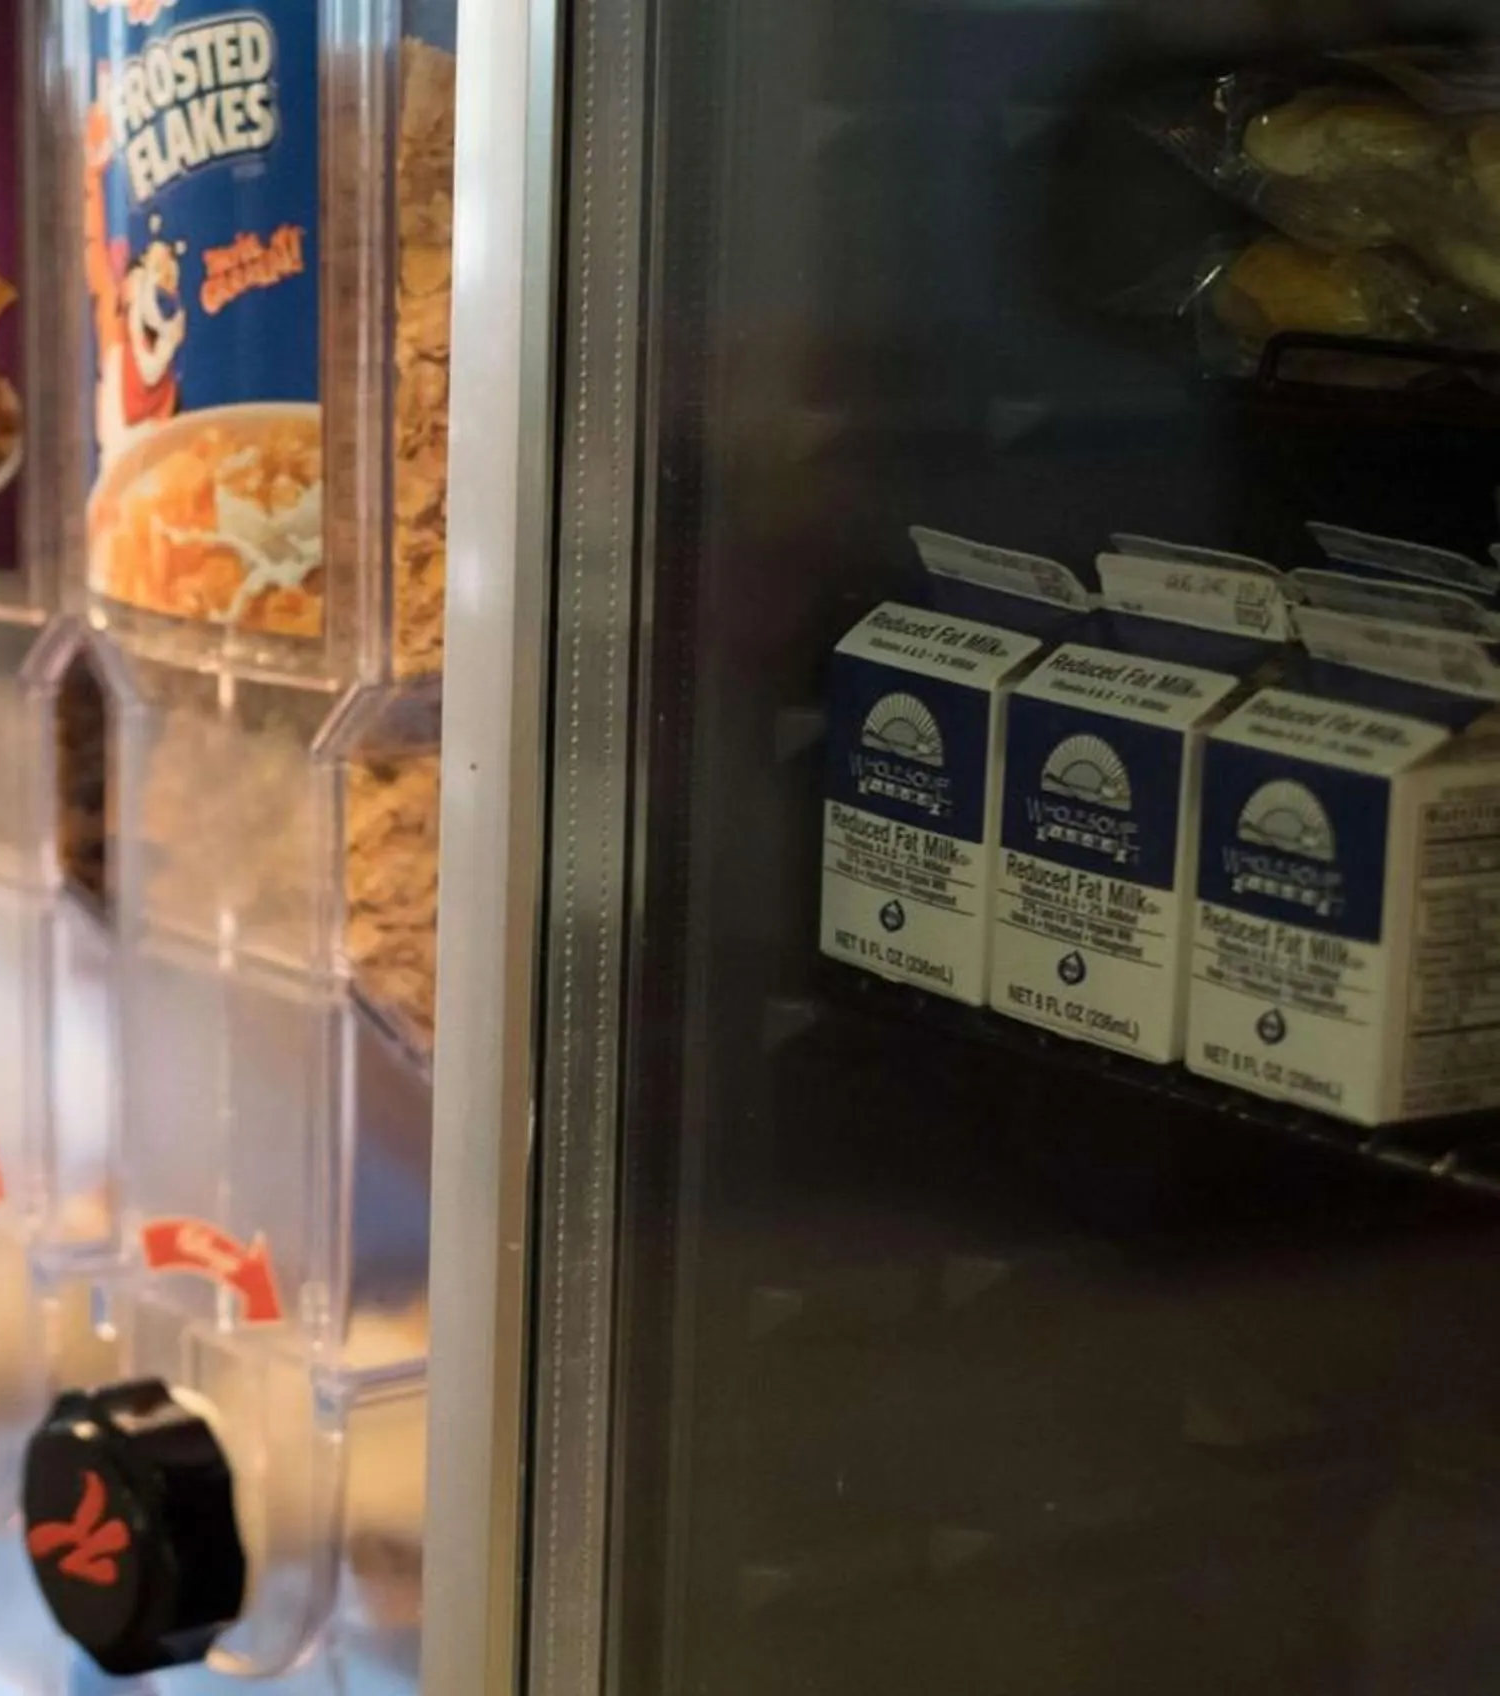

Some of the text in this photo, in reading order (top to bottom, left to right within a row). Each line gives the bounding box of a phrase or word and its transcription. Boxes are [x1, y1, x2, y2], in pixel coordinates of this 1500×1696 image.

[128, 84, 275, 203] FLAKES
[934, 626, 966, 647] Fat
[1048, 653, 1128, 681] Reduced
[1123, 667, 1156, 689] Fat
[831, 805, 891, 843] Reduced
[894, 826, 919, 854] Fat
[924, 834, 958, 862] Milk
[1006, 853, 1071, 893] Reduced
[1076, 873, 1102, 903] Fat
[1109, 881, 1147, 909] Milk
[1008, 983, 1033, 1007] NET
